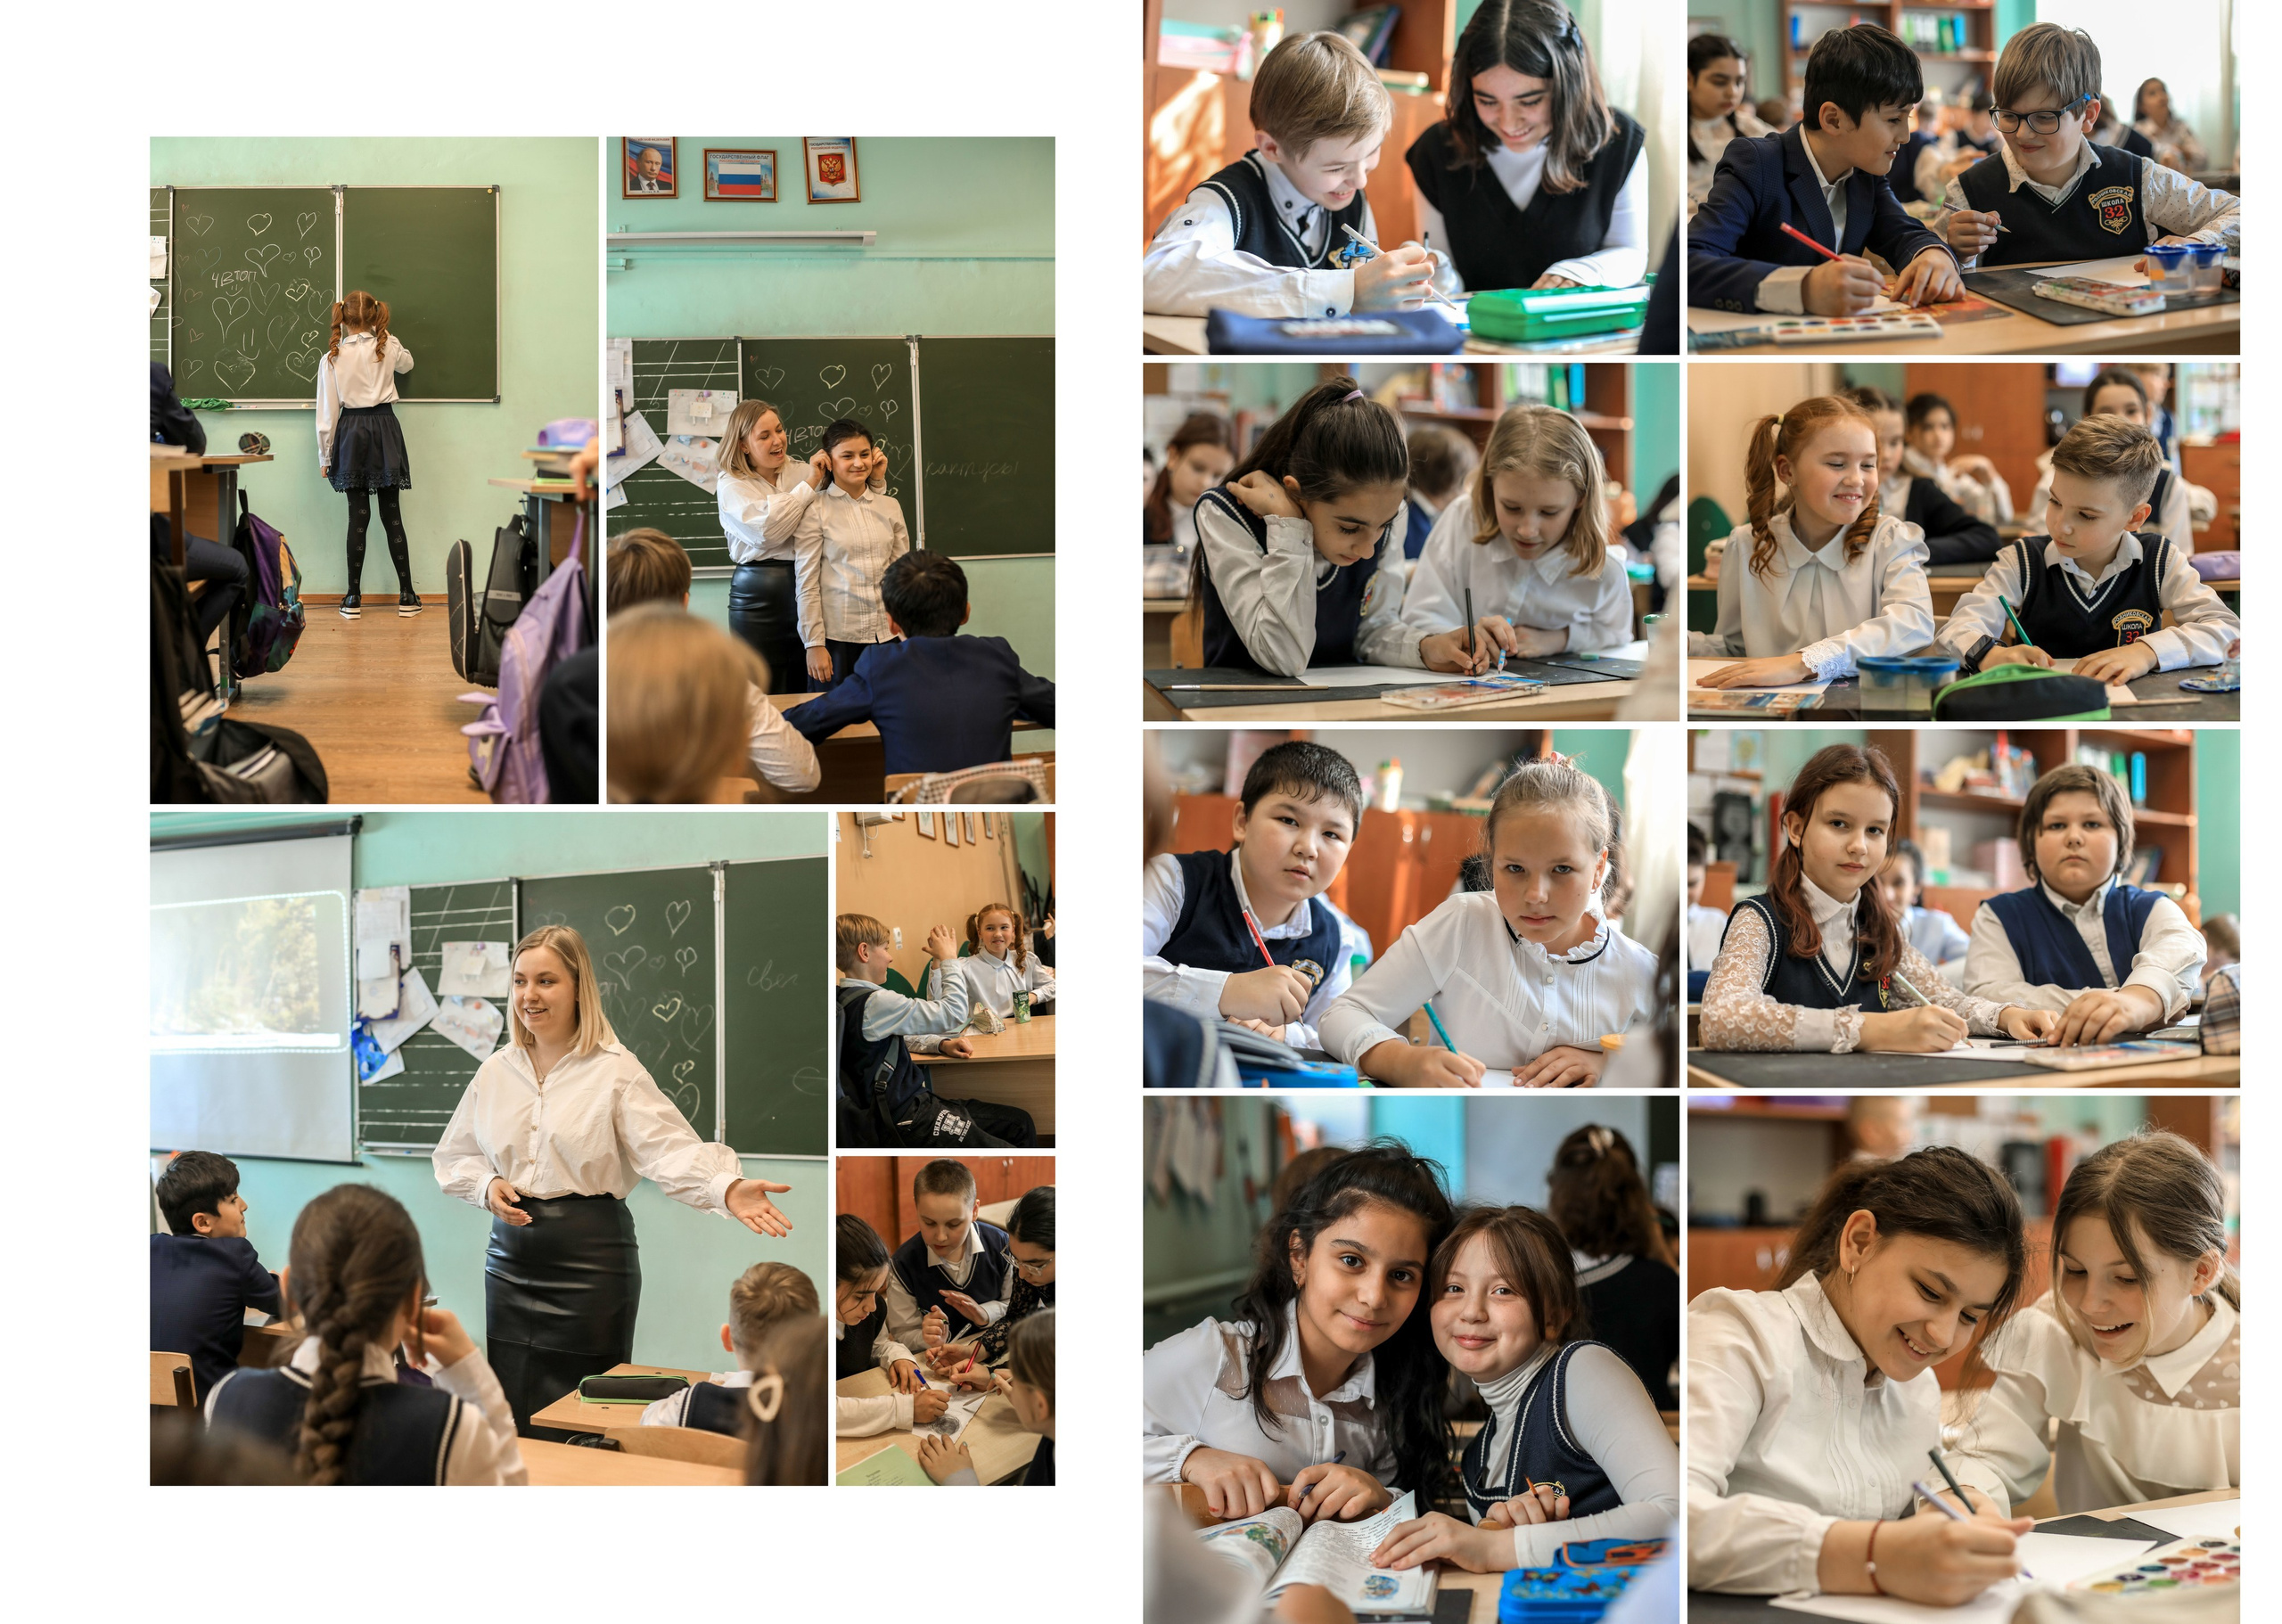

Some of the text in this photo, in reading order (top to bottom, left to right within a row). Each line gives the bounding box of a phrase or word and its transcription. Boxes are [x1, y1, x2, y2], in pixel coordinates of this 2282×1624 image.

[2091, 188, 2132, 204] РОДНИКОВСКАЯ
[2101, 198, 2125, 208] ШКОЛА
[2105, 204, 2125, 219] 32
[2114, 611, 2151, 624] РОДНИКОВСКАЯ
